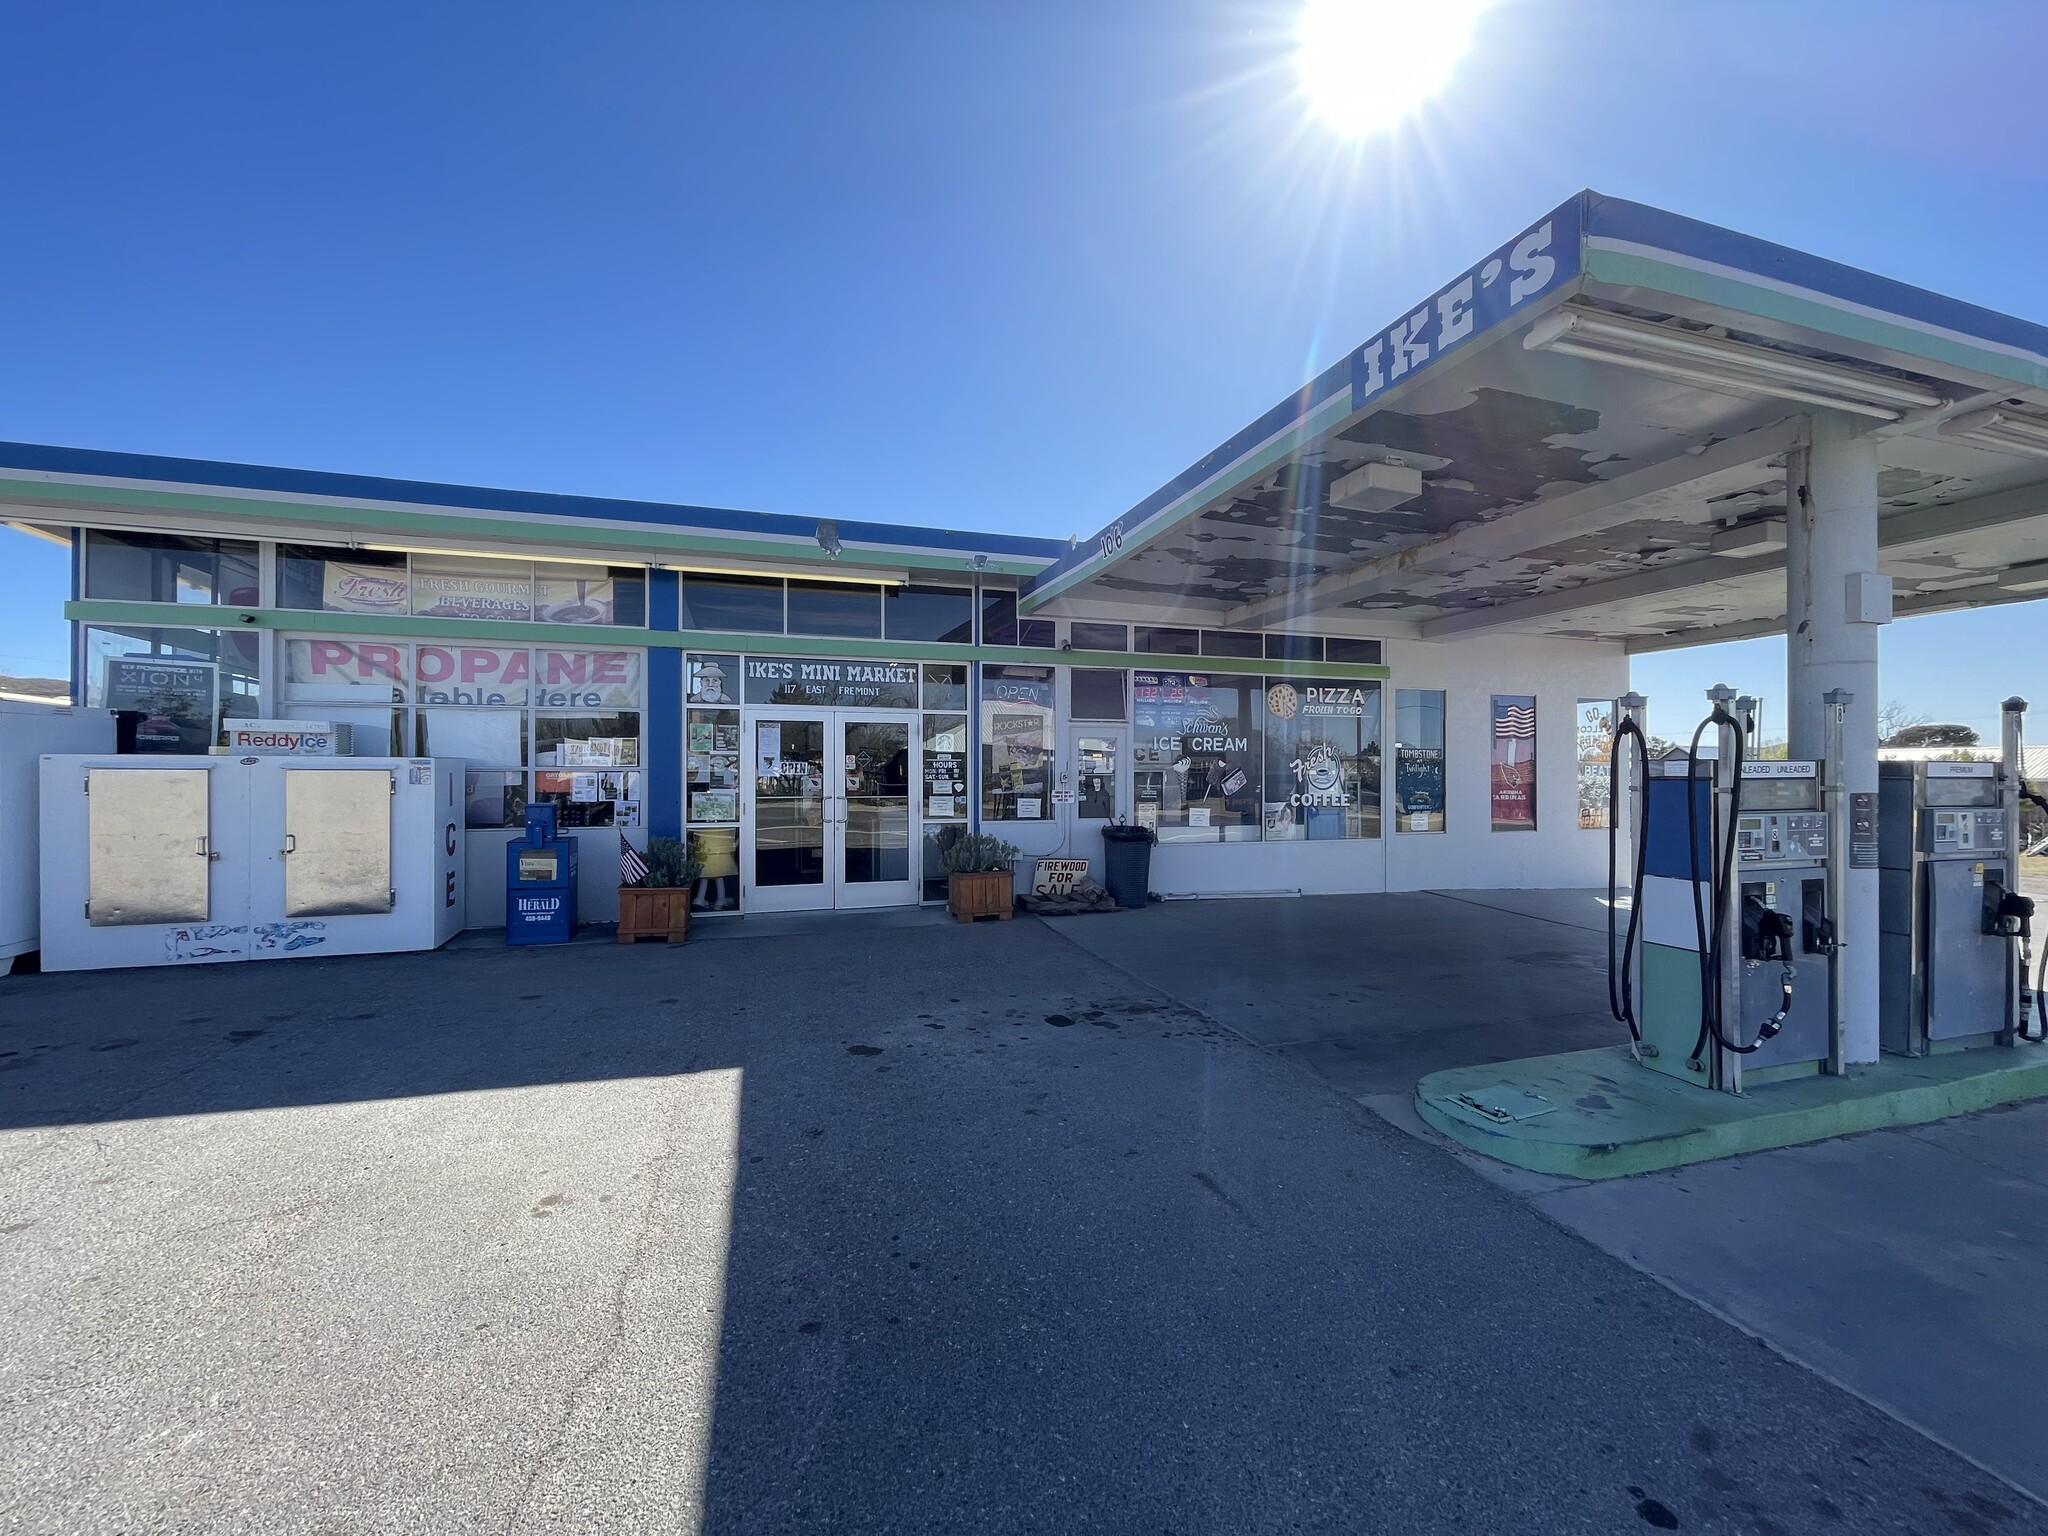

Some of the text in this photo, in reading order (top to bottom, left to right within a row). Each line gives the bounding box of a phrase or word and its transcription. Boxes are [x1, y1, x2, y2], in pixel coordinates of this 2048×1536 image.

[1364, 220, 1556, 398] IKE'S
[420, 579, 469, 592] FRESH
[441, 596, 530, 611] BEVERAGES
[310, 641, 628, 684] PROPANE
[749, 662, 916, 684] IKE'S MINI MARKET
[784, 684, 880, 696] 117 EAST FREMONT
[996, 685, 1039, 702] OPEN
[1306, 687, 1365, 705] PIZZA
[1176, 718, 1229, 736] Schwan's
[1153, 737, 1248, 752] ICE CREAM
[1400, 749, 1439, 759] TOMBSTONE
[781, 762, 807, 774] OPEN
[933, 761, 957, 769] HOURS
[1289, 742, 1336, 783] Fresh
[1741, 765, 1811, 774] NLEADED UNLEADED
[1949, 765, 1974, 774] PREMIUM
[1405, 763, 1430, 778] Twilight
[1290, 793, 1351, 807] COFFEE
[1772, 830, 1778, 840] 8
[1037, 861, 1087, 872] FIREWOOD
[1049, 872, 1073, 883] FOR
[518, 897, 560, 911] HERALD
